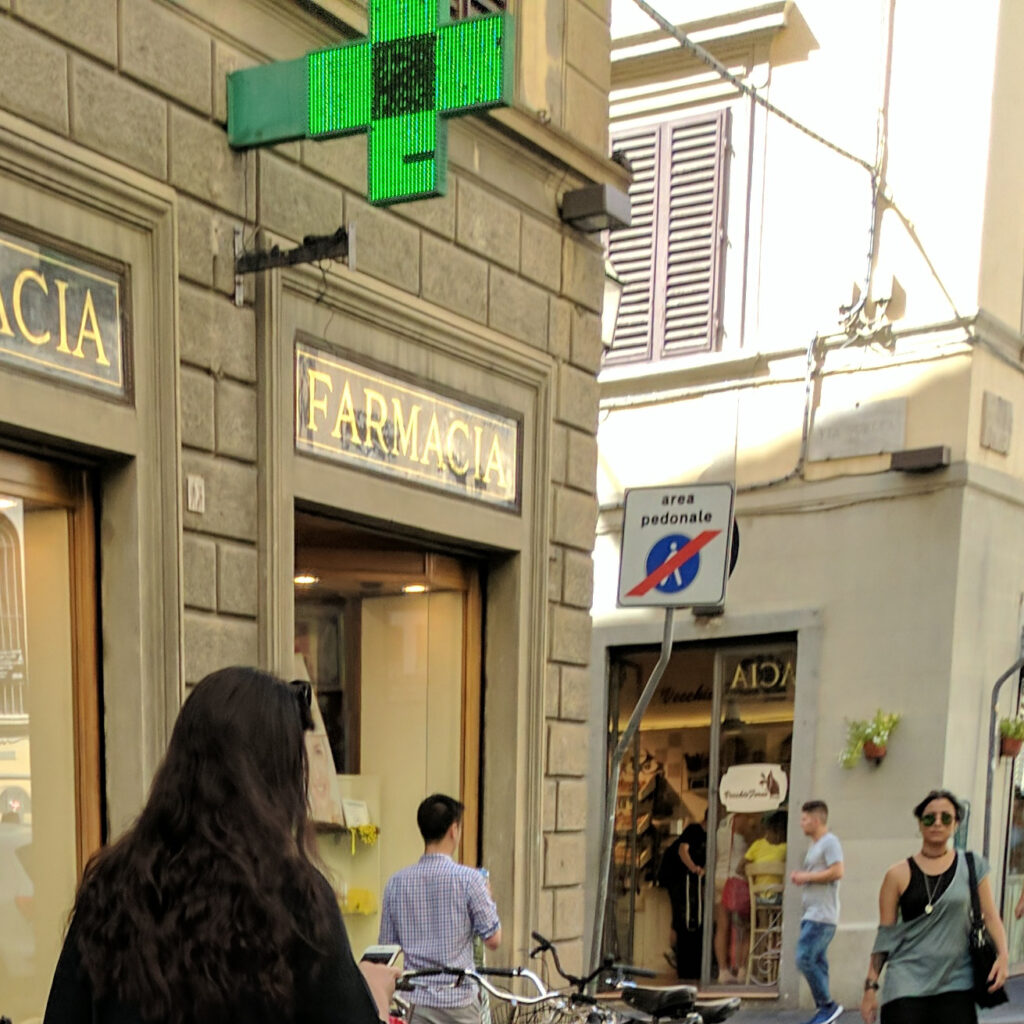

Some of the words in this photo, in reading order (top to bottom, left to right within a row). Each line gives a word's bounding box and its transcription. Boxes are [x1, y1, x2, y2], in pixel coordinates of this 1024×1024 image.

[306, 368, 509, 488] FARMACIA
[661, 493, 695, 507] area
[640, 508, 713, 529] pedonale
